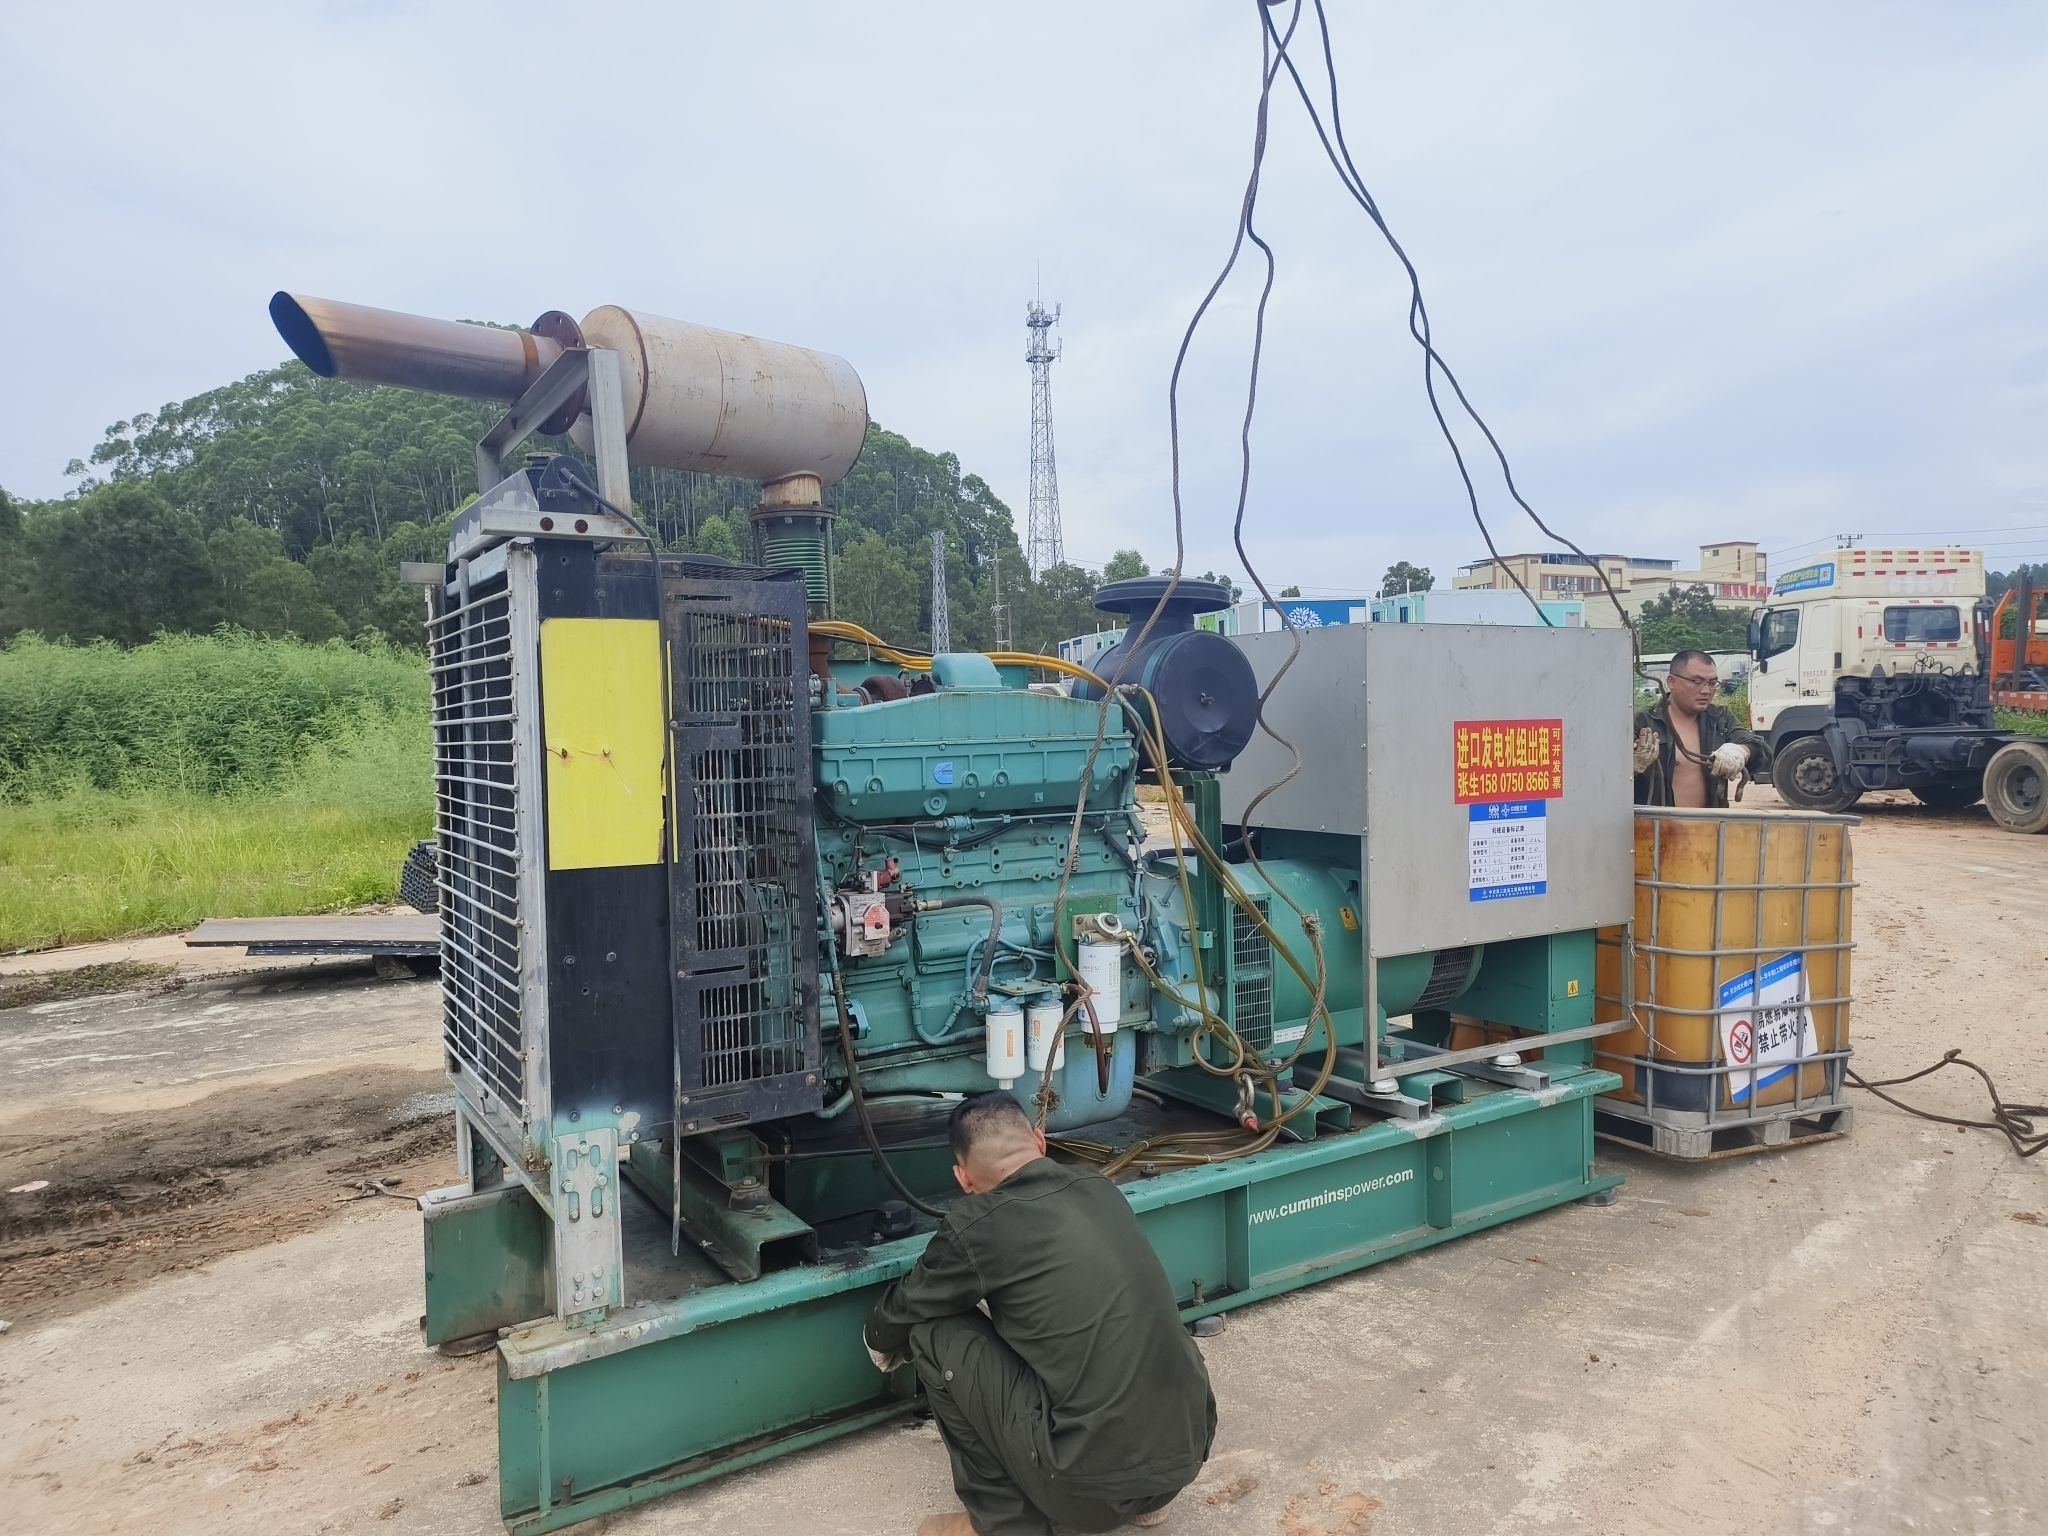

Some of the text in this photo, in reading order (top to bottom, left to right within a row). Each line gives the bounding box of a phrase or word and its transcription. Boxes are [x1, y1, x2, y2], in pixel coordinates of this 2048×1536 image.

[1457, 726, 1550, 769] 进口发电机组出租
[1551, 727, 1561, 789] 可开发票
[1500, 772, 1524, 793] 0750
[1526, 771, 1549, 791] 8566
